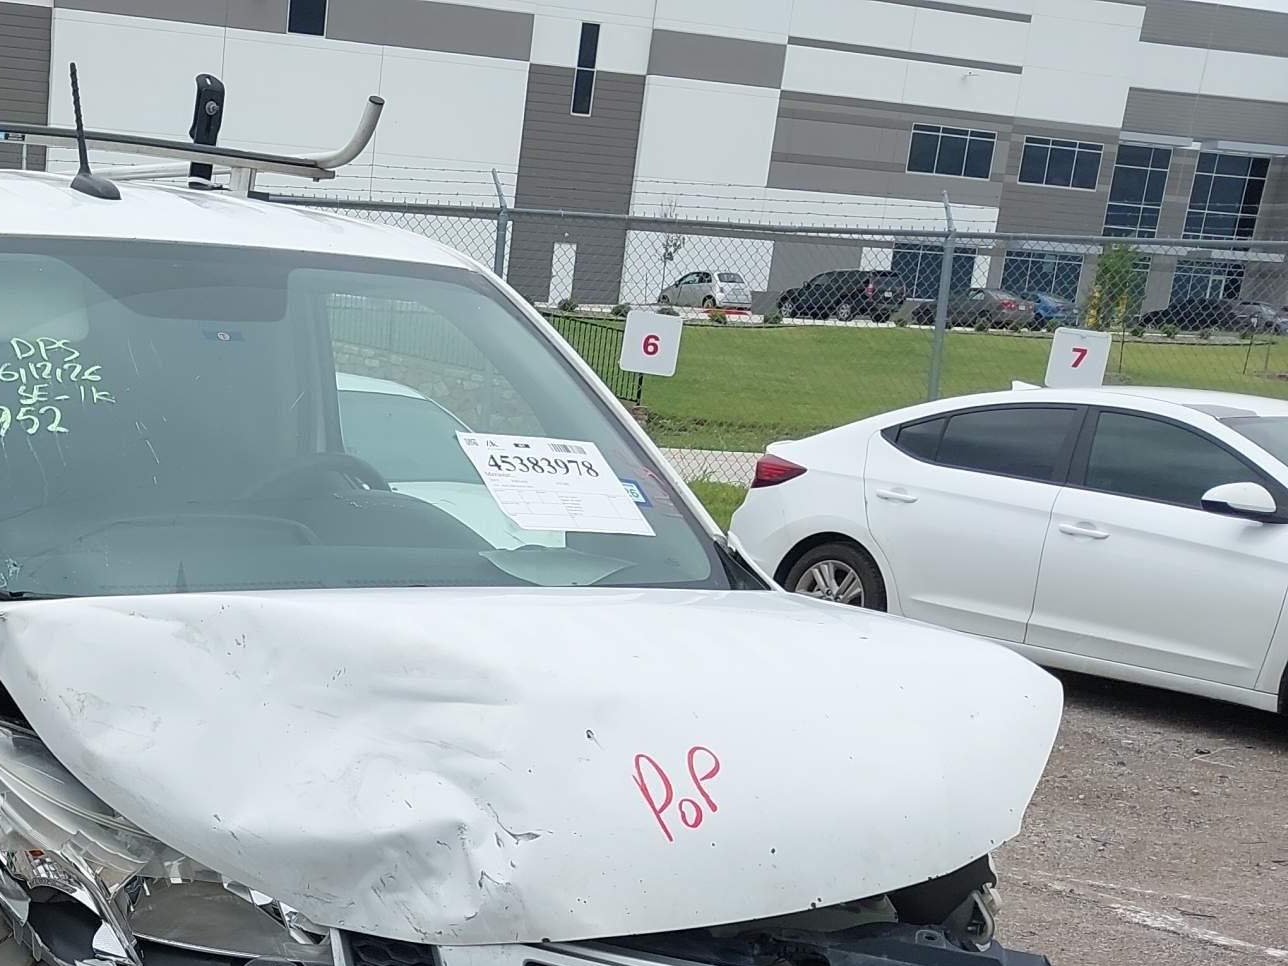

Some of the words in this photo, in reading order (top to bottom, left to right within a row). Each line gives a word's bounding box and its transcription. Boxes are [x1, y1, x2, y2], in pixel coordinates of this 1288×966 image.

[10, 336, 81, 362] DPS
[642, 334, 661, 356] 6
[1071, 347, 1088, 368] 7
[487, 454, 600, 478] 45383978
